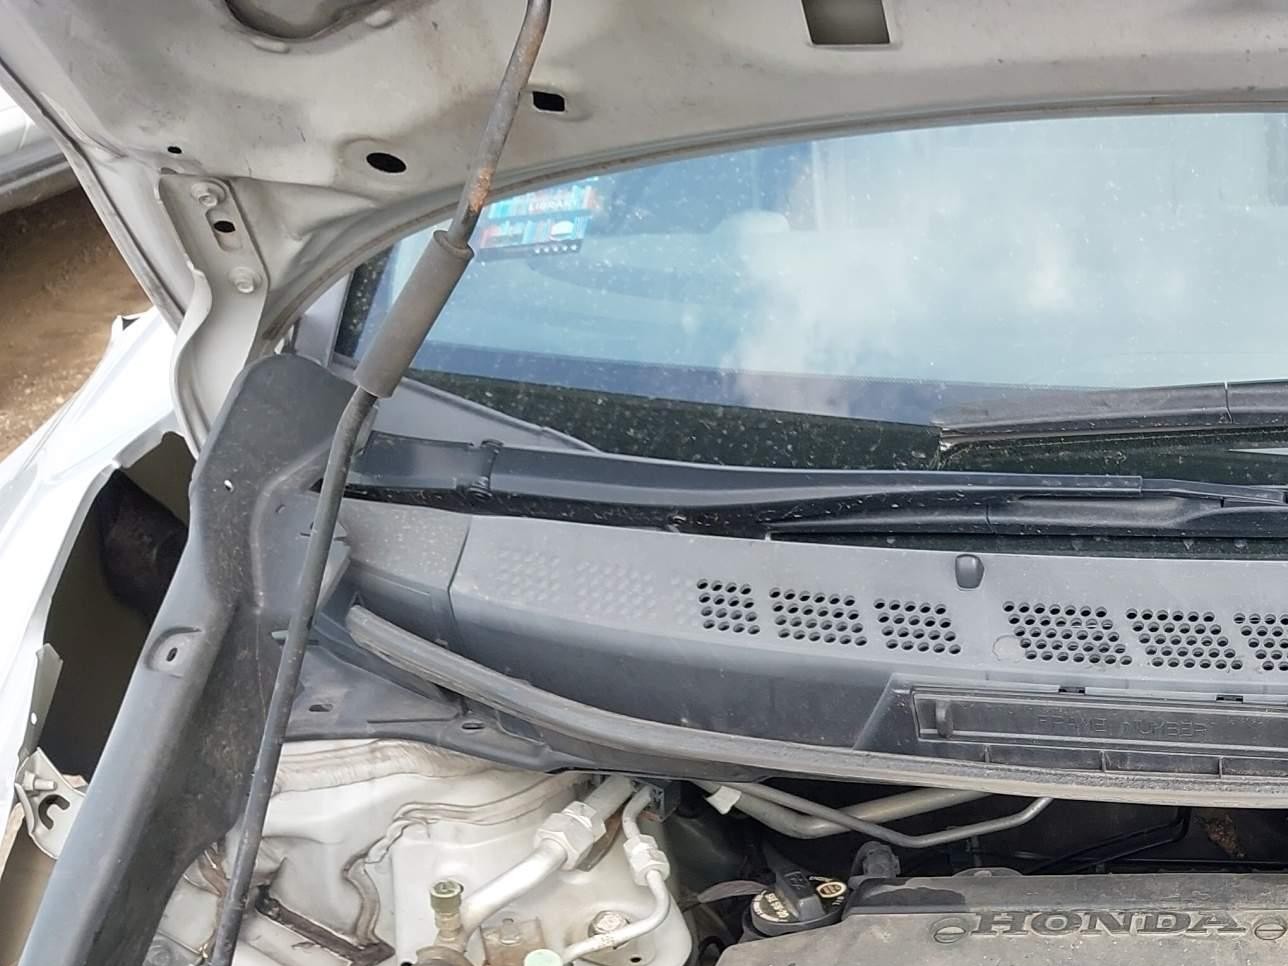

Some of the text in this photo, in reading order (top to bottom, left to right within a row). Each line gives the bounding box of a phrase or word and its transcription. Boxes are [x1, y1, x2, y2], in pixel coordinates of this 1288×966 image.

[1037, 713, 1210, 740] FRAME NUMBER
[970, 910, 1247, 937] HONDA
